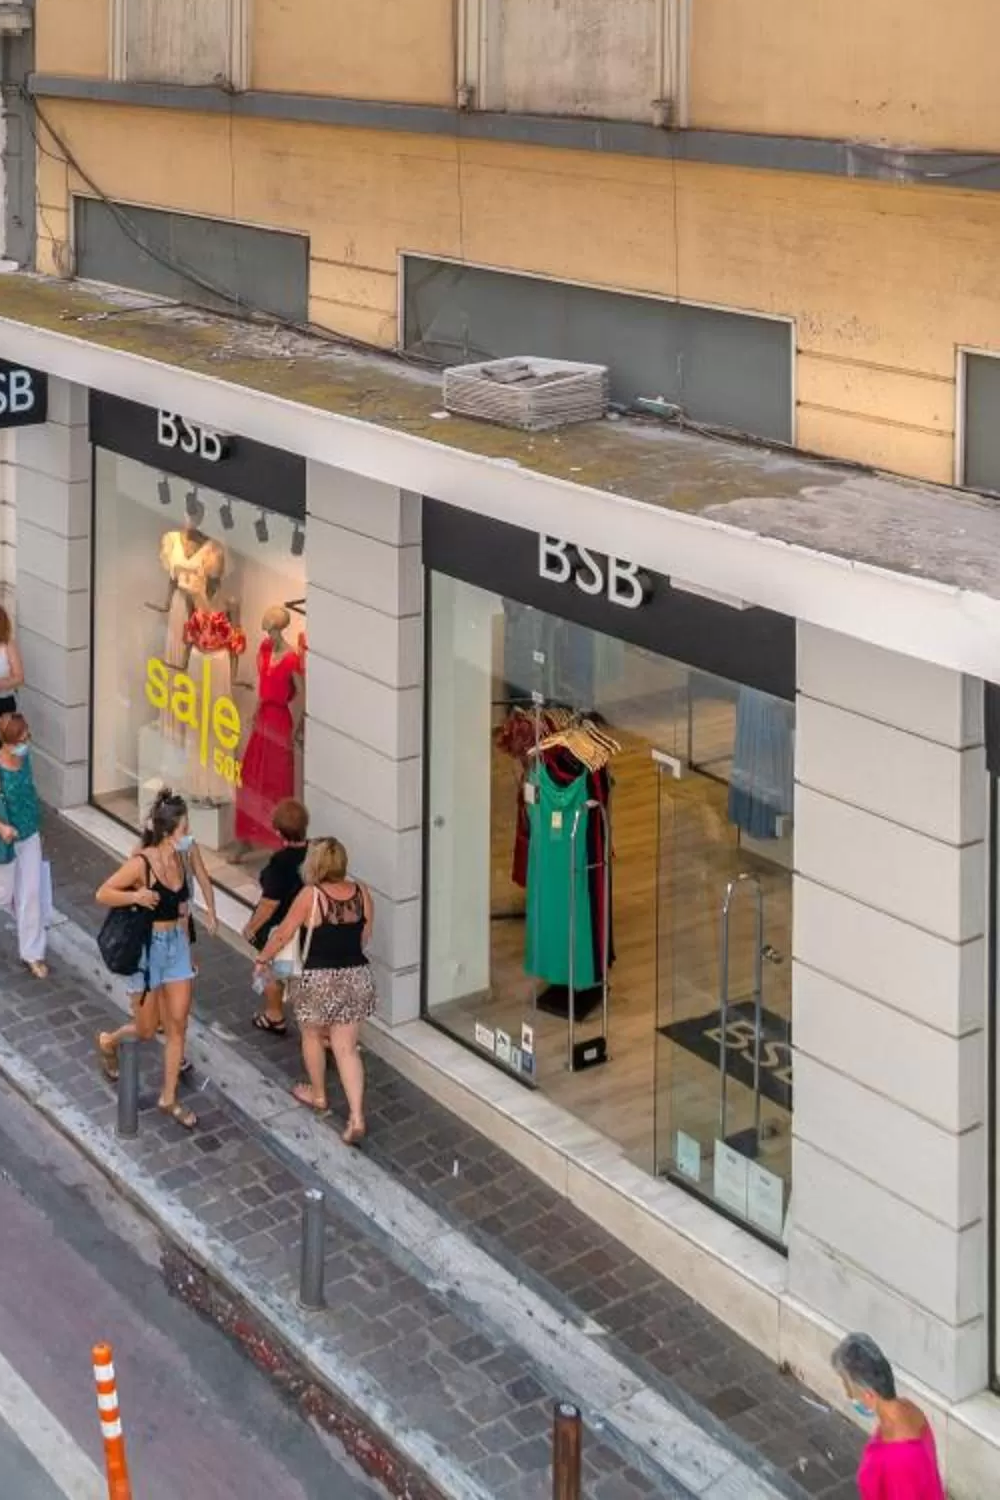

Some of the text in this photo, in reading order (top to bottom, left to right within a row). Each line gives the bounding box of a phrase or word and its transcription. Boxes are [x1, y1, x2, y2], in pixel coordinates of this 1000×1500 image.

[539, 531, 643, 609] BSB
[145, 656, 241, 769] sale
[703, 1019, 792, 1085] BS
